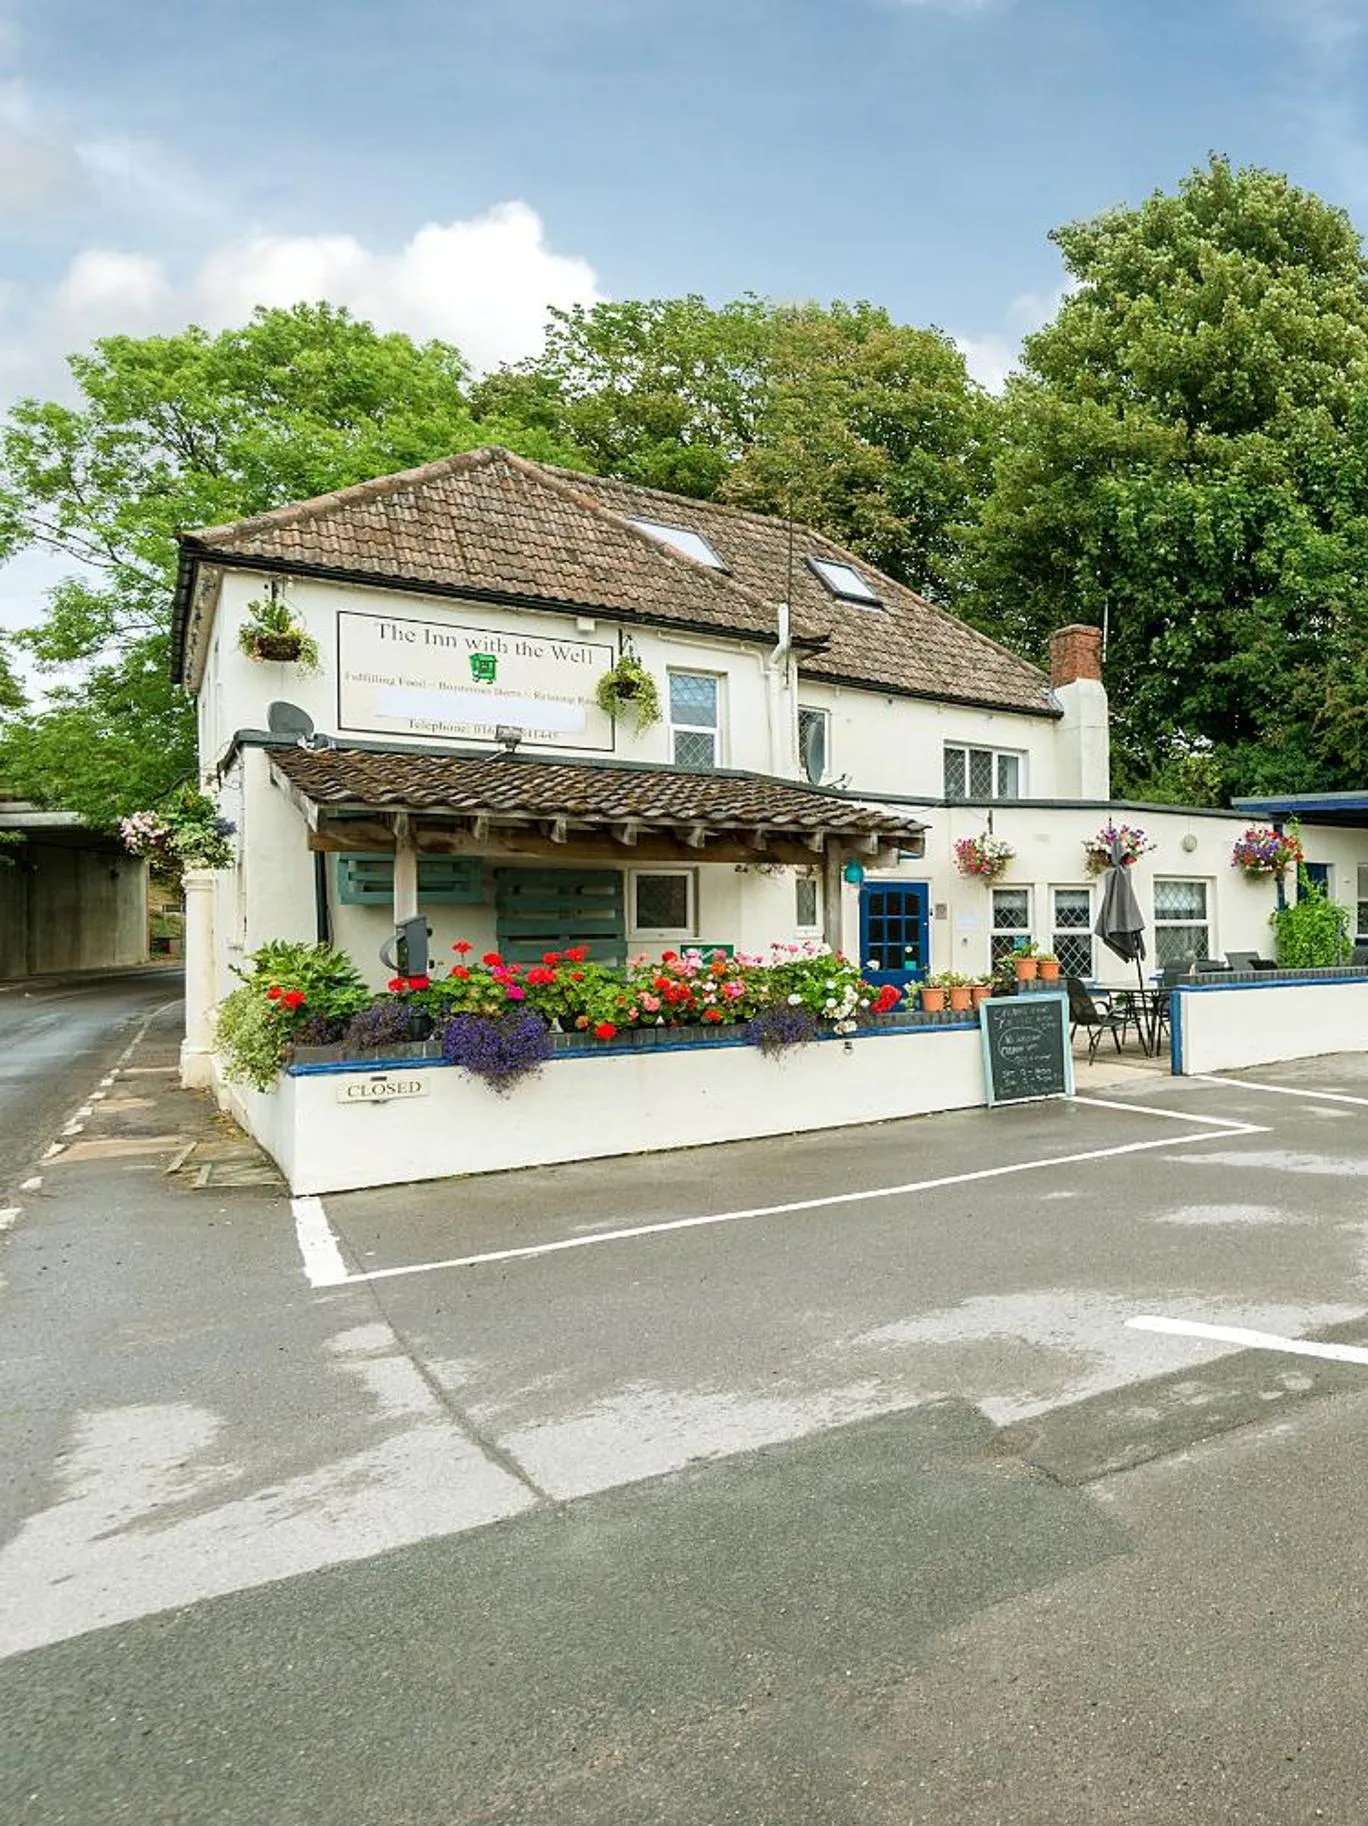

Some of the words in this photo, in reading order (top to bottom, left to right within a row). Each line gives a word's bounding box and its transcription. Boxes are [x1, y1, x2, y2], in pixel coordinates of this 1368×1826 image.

[375, 622, 416, 643] The
[424, 628, 458, 650] Inn
[465, 636, 508, 655] with
[515, 641, 544, 660] the
[550, 645, 593, 666] Well
[344, 670, 395, 687] Fulfilling
[398, 676, 427, 688] Food
[347, 1080, 423, 1097] CLOSED
